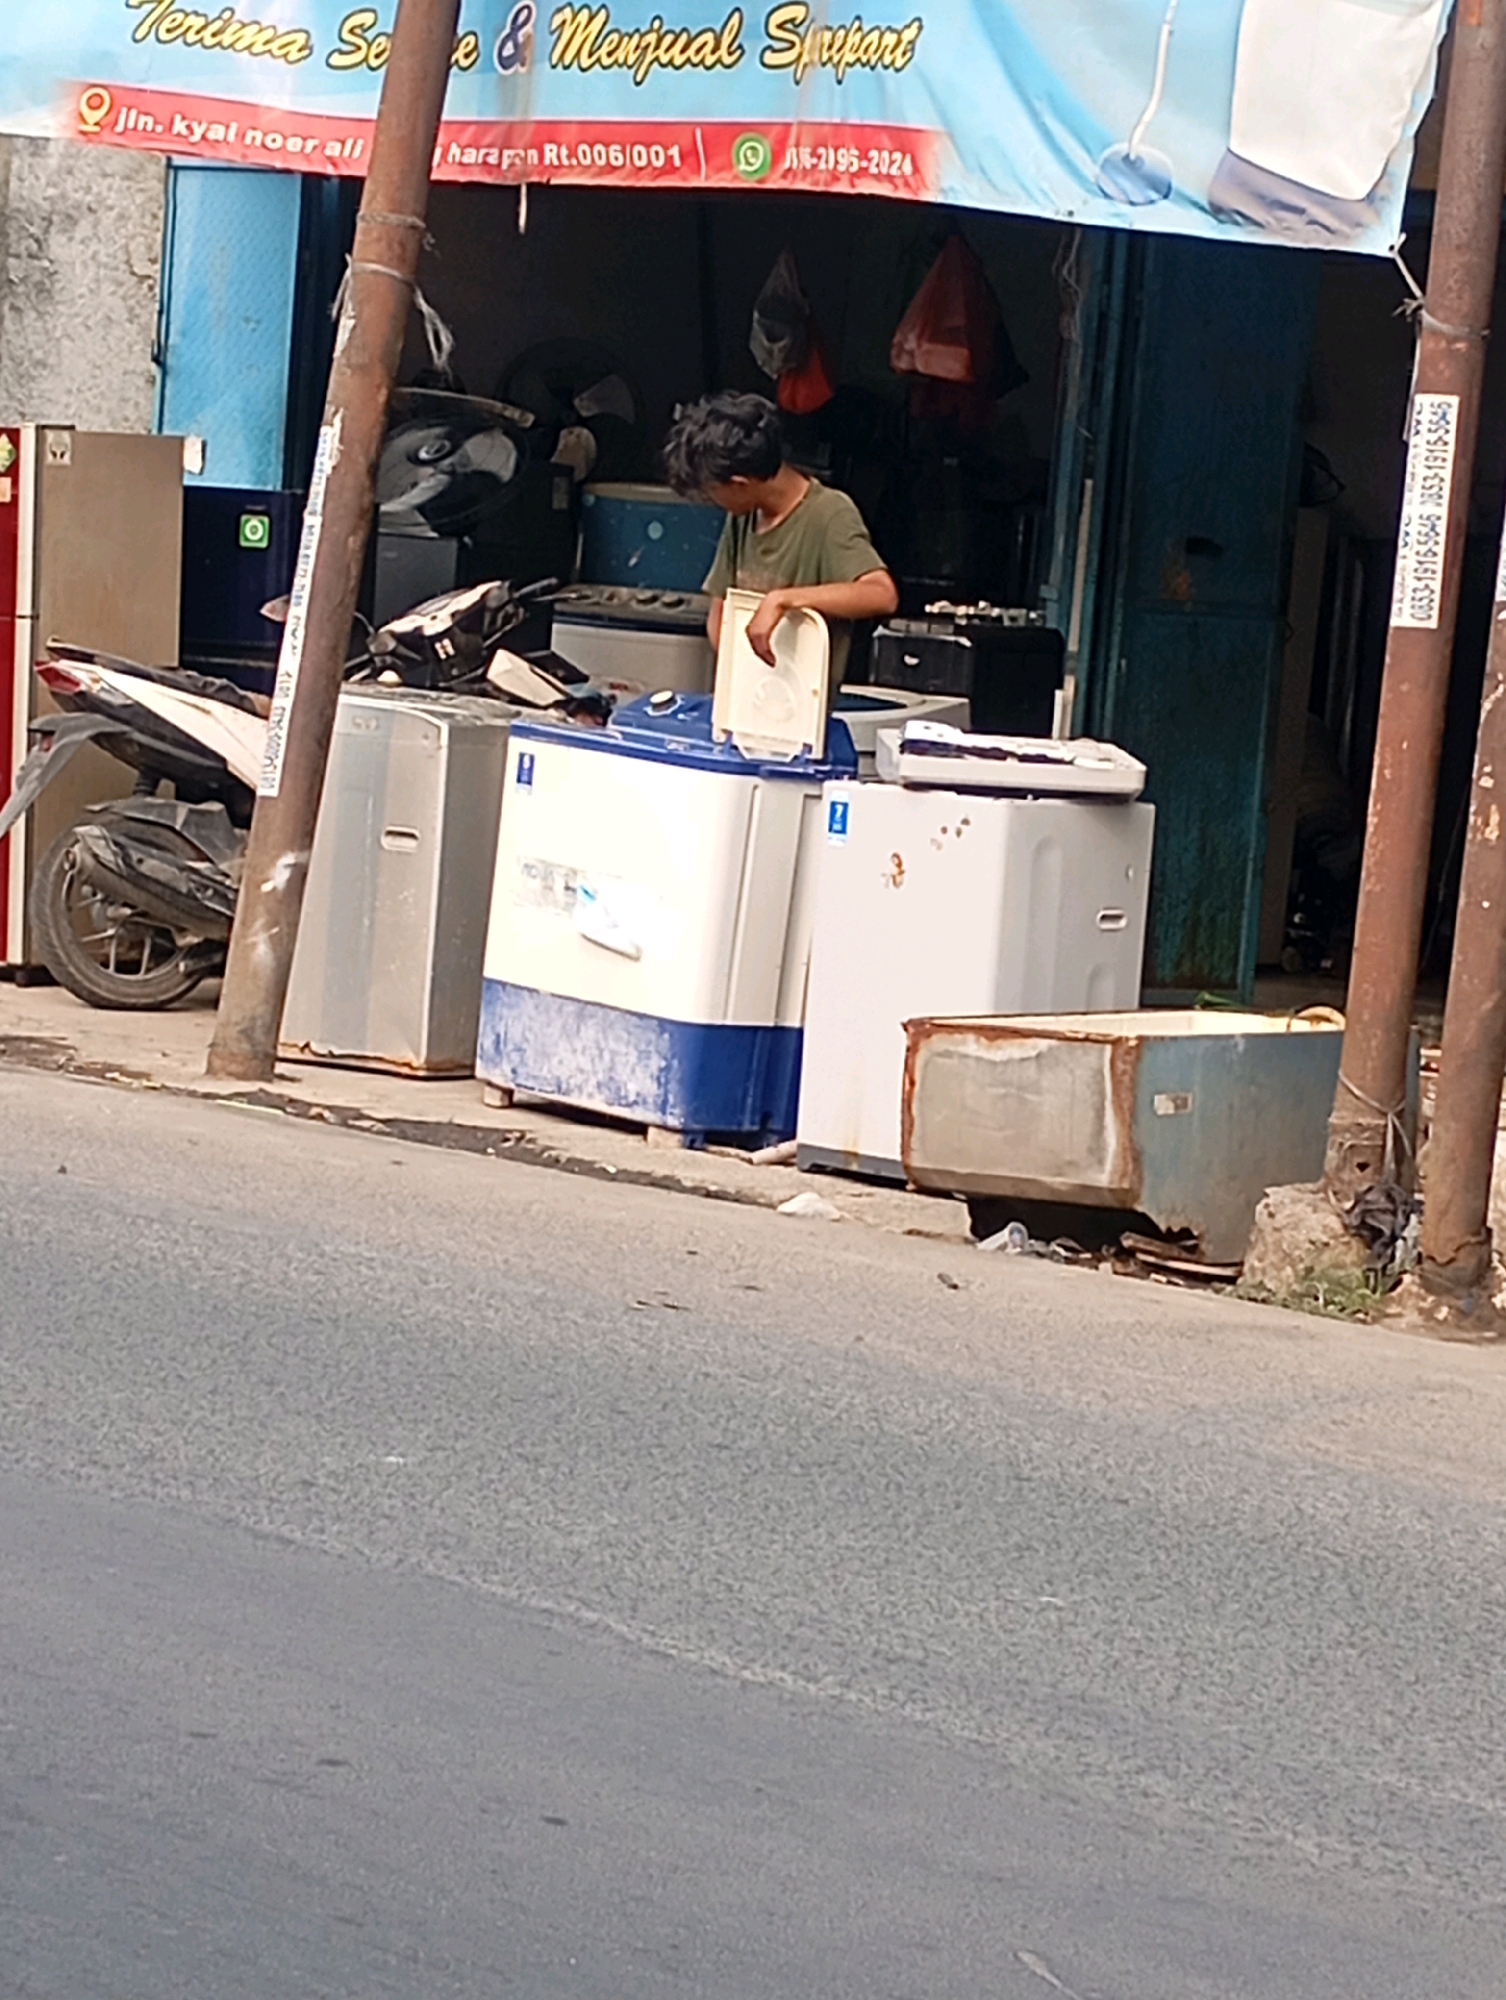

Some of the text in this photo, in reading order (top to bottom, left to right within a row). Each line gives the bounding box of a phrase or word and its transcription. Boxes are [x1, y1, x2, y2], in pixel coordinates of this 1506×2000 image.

[125, 0, 313, 65] Terima
[496, 2, 533, 73] &
[549, 2, 745, 86] Menjual
[114, 106, 164, 134] jln.
[243, 126, 320, 155] noer
